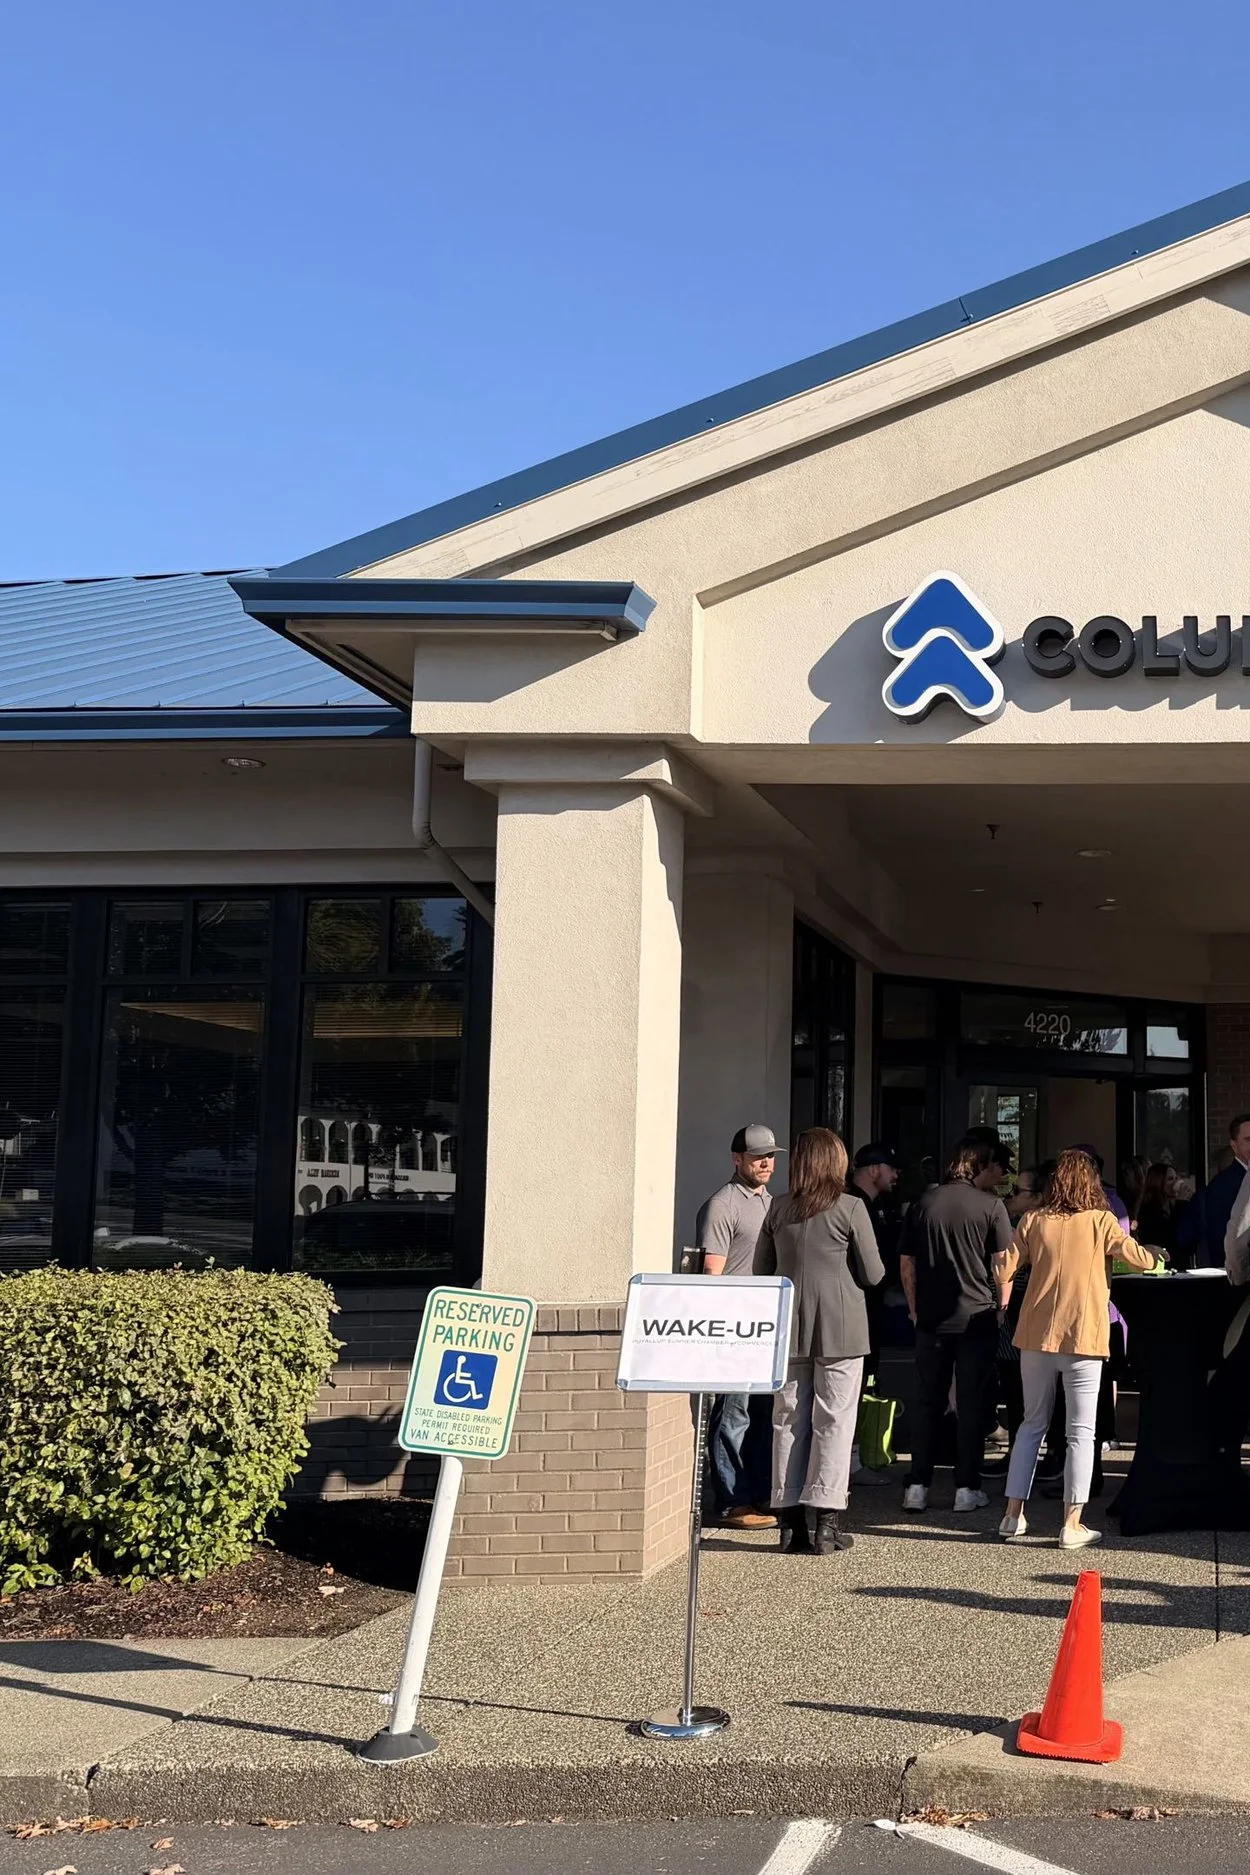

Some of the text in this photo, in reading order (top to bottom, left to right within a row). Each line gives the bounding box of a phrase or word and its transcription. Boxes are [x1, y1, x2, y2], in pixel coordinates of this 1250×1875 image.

[1024, 1012, 1071, 1035] 4220
[434, 1299, 525, 1327] RESERVED
[432, 1325, 516, 1352] PARKING
[643, 1319, 775, 1338] WAKE-UP
[415, 1408, 502, 1426] STATE DISABLED PARKING
[422, 1419, 490, 1434] PERMIT REQUIRED
[411, 1428, 498, 1449] VAN ACCESSIBLE
